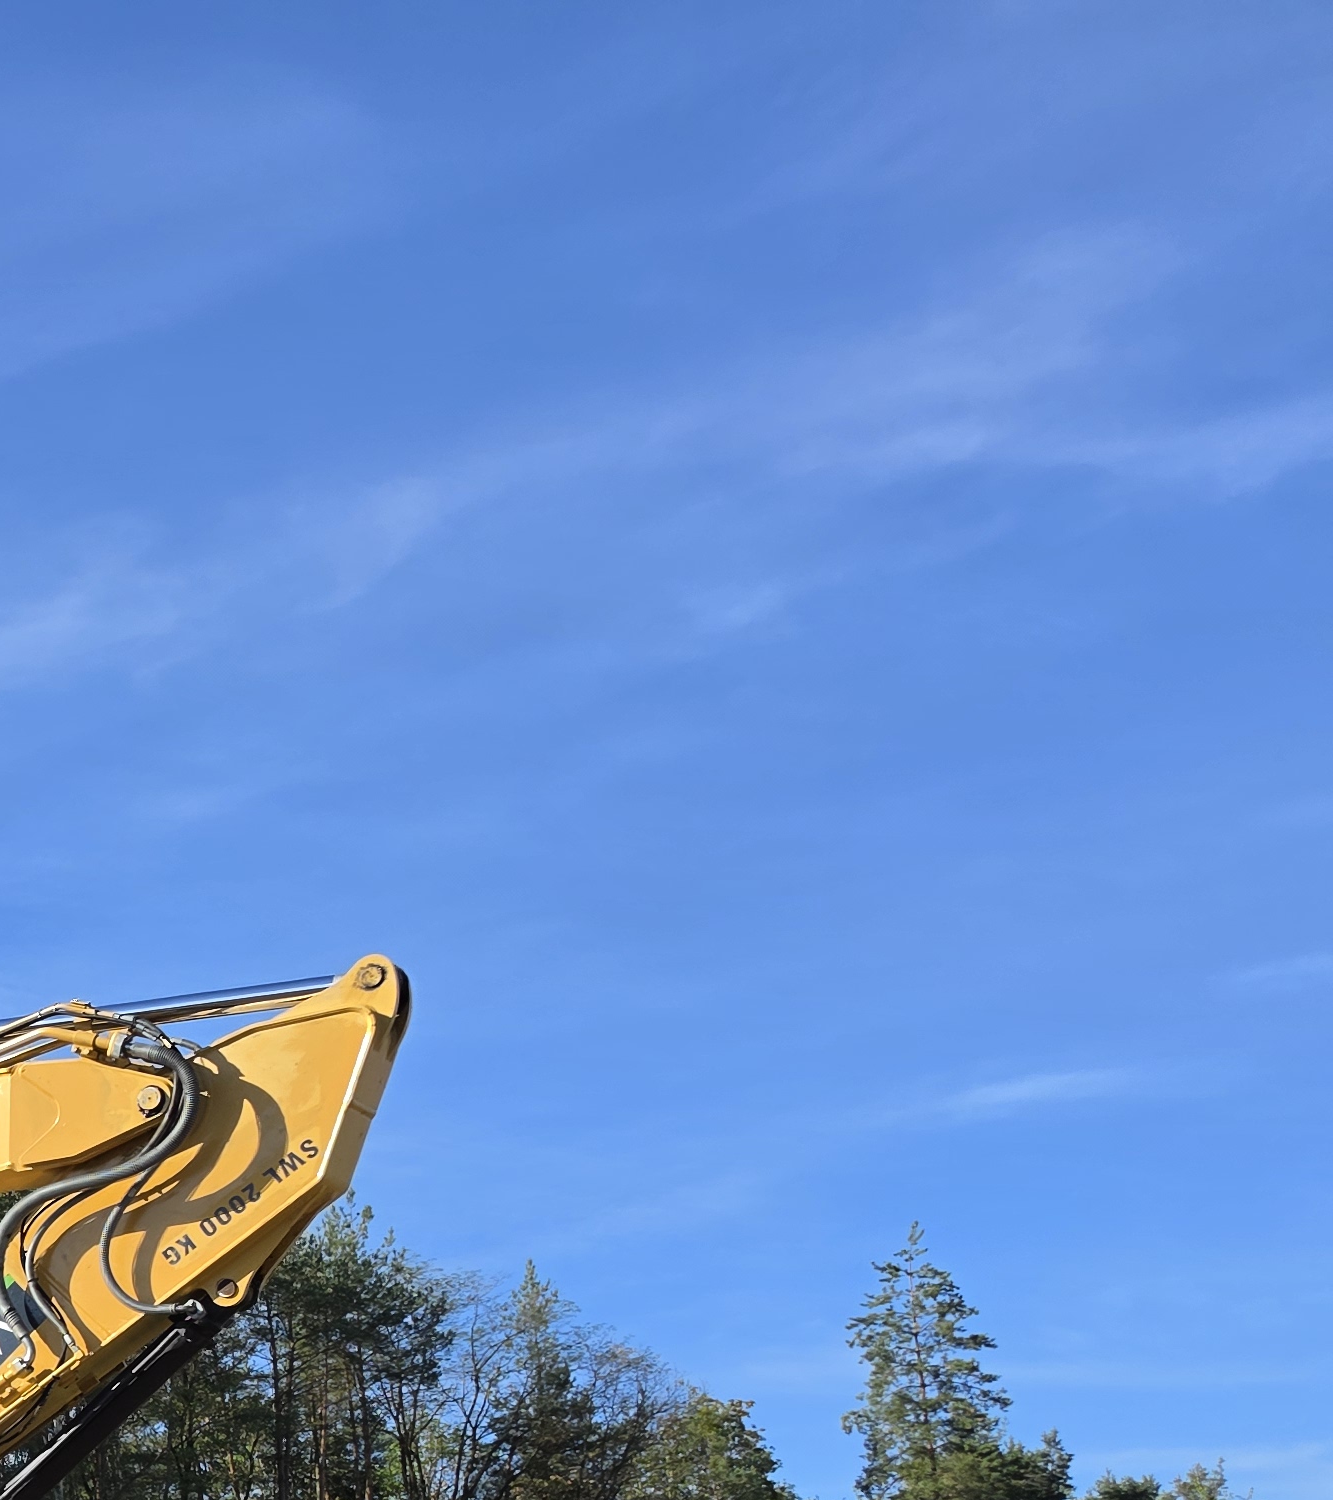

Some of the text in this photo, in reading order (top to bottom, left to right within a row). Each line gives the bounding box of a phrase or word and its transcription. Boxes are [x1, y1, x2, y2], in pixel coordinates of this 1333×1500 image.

[161, 1139, 319, 1265] SWL 2000 KG
